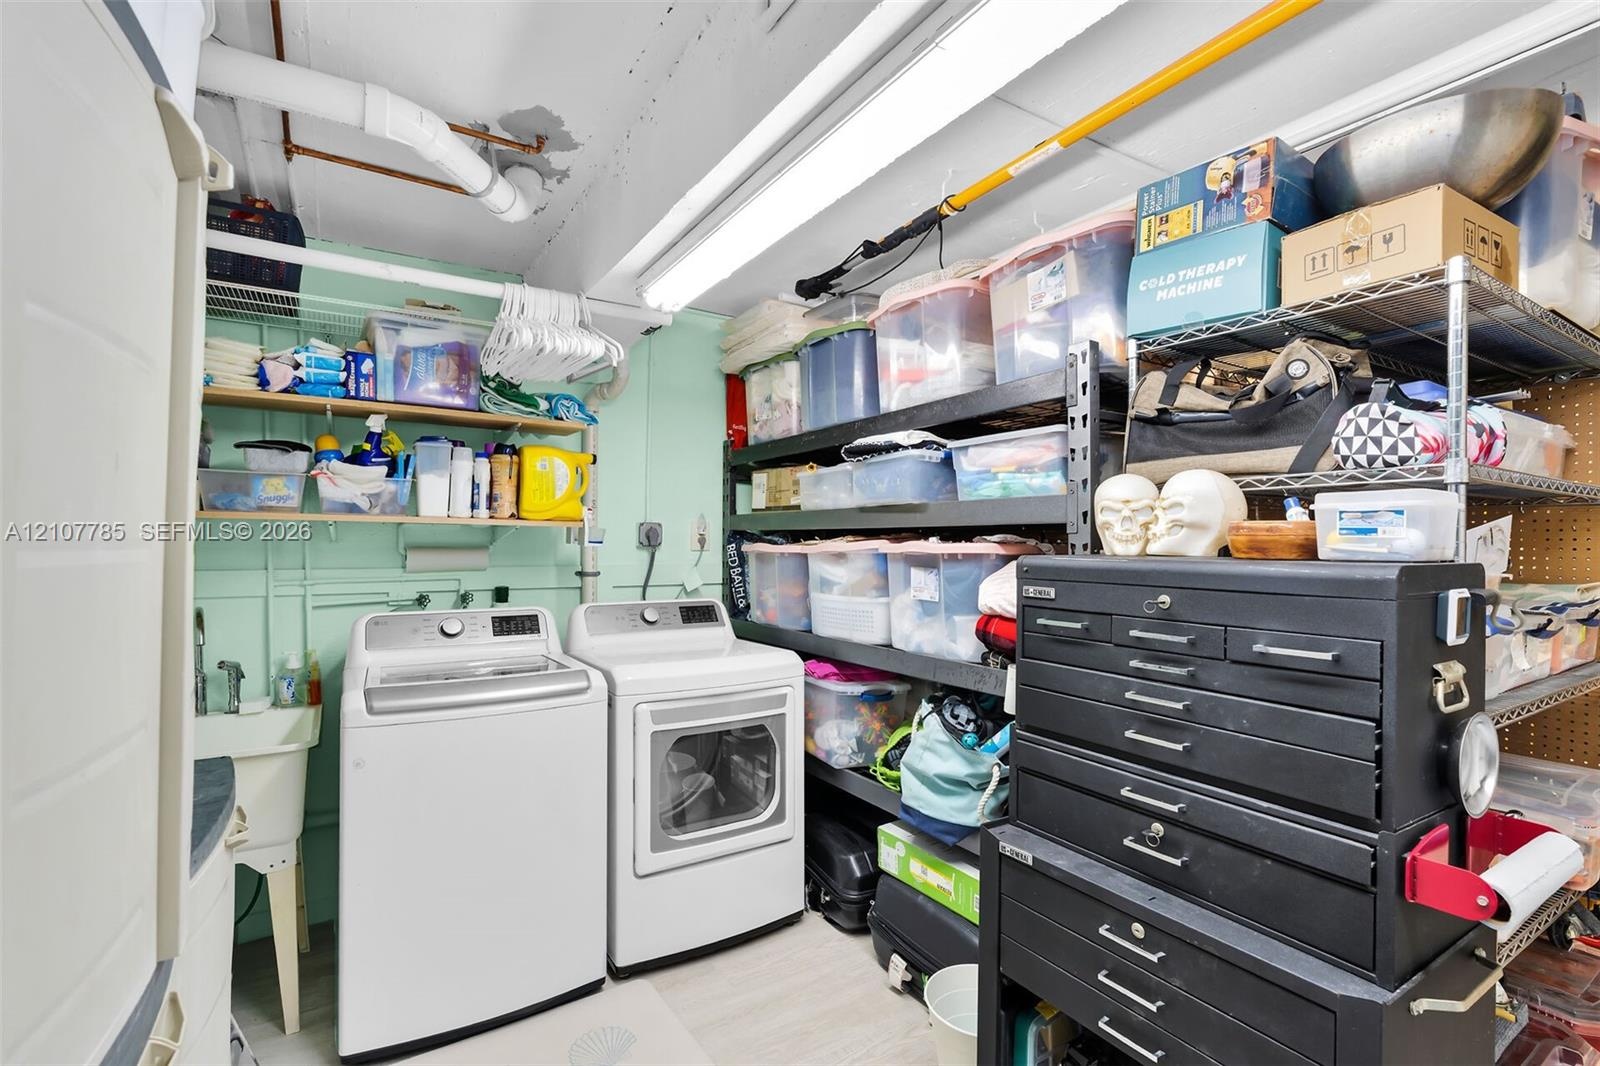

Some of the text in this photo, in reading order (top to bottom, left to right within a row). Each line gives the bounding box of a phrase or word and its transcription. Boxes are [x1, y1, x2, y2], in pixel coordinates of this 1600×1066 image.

[1141, 192, 1149, 216] Power
[1144, 218, 1153, 249] WAGNER
[1138, 254, 1248, 292] COLD THERAPY
[1156, 275, 1224, 302] MACHINE
[726, 543, 738, 566] BED
